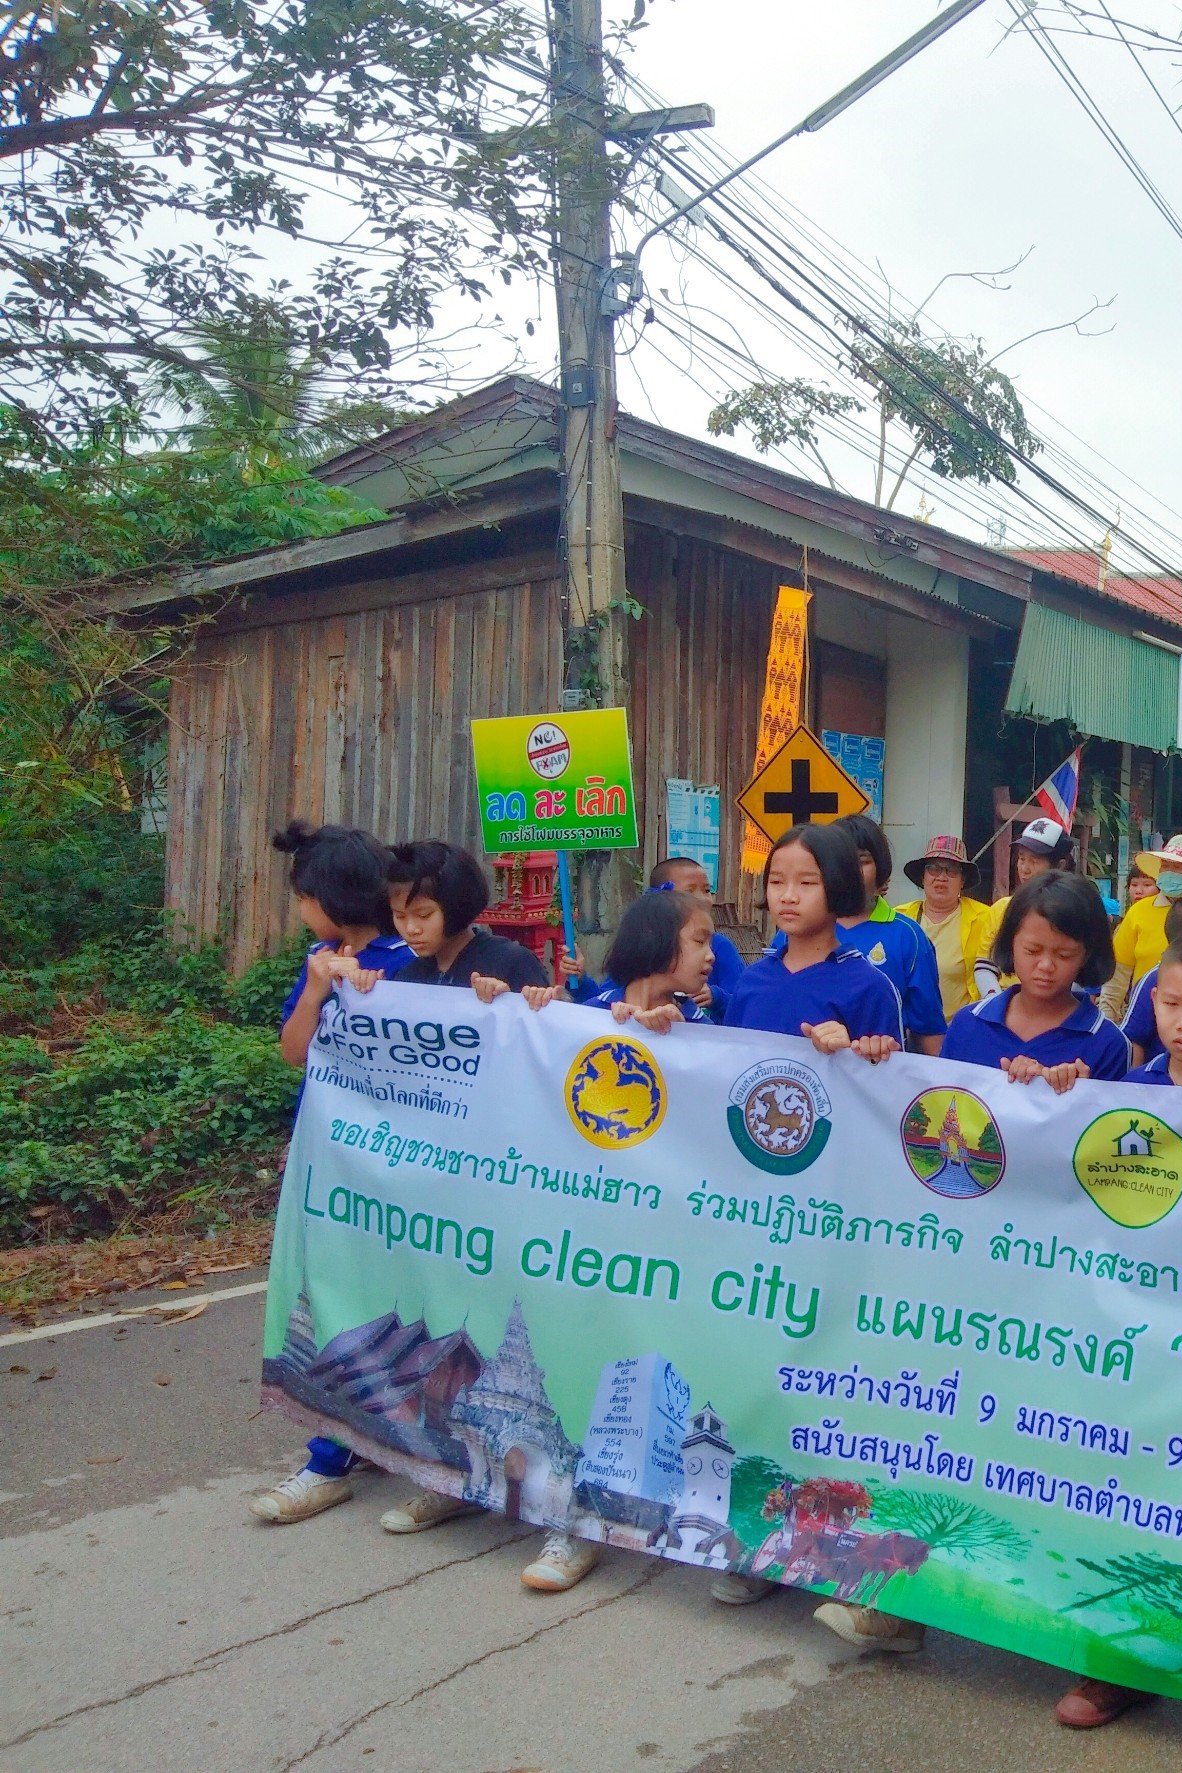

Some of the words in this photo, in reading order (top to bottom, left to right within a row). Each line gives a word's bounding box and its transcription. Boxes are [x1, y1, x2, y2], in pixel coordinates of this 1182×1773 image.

[486, 791, 526, 822] ลด
[535, 789, 567, 820] ละ
[576, 776, 627, 819] เลิก
[498, 824, 624, 844] การใช้โฟมบรรจุอาหาร
[332, 1032, 378, 1061] For
[388, 1044, 481, 1077] Good
[308, 1060, 468, 1120] เปลี่ยนเพื่อโลกที่ดีกว่า
[329, 1117, 662, 1210] ขอเชิญชวนชาวบ้านแม่ฮาว
[686, 1179, 964, 1254] ร่วมปฏิบัติภารกิจ
[1087, 1161, 1179, 1181] ลำปางสะอาด
[1156, 1186, 1174, 1198] CITY
[303, 1164, 494, 1277] Lampang
[521, 1229, 681, 1301] clean
[711, 1263, 820, 1339] city
[856, 1294, 1149, 1382] แผนรณรงค์
[620, 1368, 630, 1376] 92
[615, 1385, 630, 1394] 225
[611, 1405, 627, 1413] 458
[778, 1364, 960, 1415] ระหว่างวันที่
[980, 1394, 997, 1424] 9
[1016, 1405, 1129, 1456] มกราคม
[604, 1438, 622, 1448] 554
[791, 1418, 974, 1480] สนับสนุนโดย
